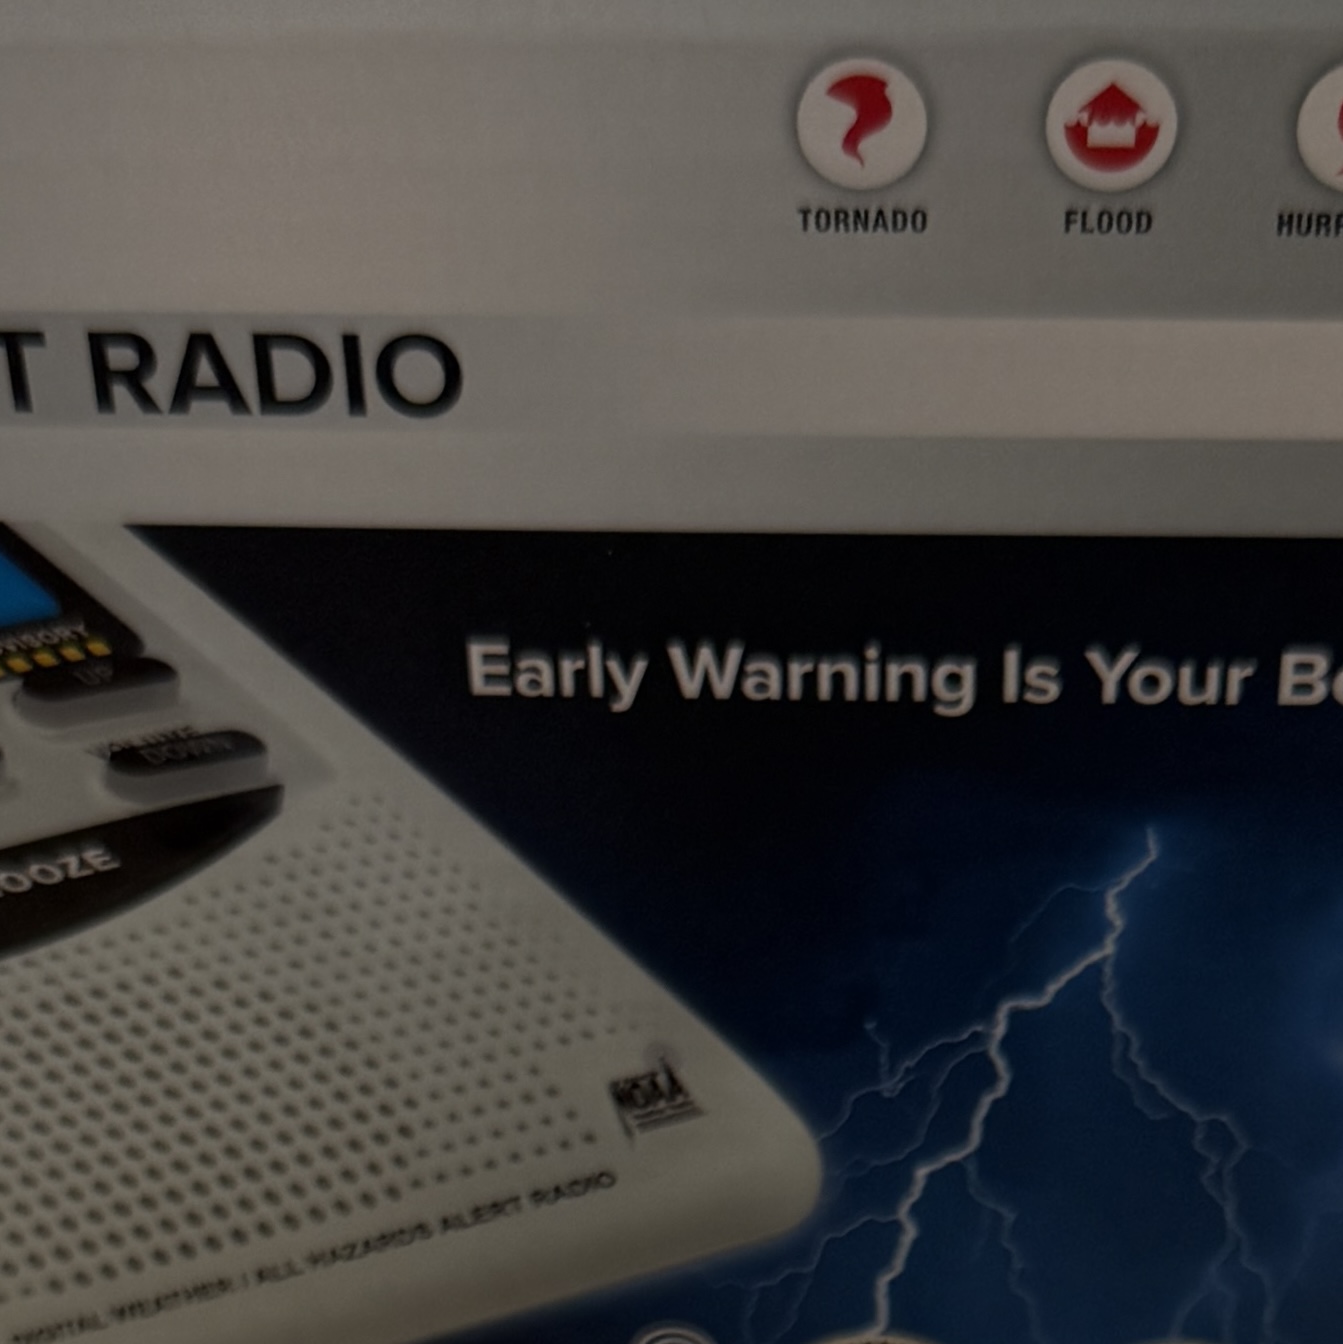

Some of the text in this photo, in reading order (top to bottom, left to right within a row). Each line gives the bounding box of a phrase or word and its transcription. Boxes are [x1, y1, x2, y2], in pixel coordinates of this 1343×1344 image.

[797, 208, 929, 236] TORNADO
[1063, 209, 1154, 237] FLOOD
[86, 331, 463, 418] RADIO
[467, 641, 647, 713] Early
[667, 643, 978, 716] Warning
[1002, 646, 1061, 705] Is
[1084, 648, 1254, 708] Your
